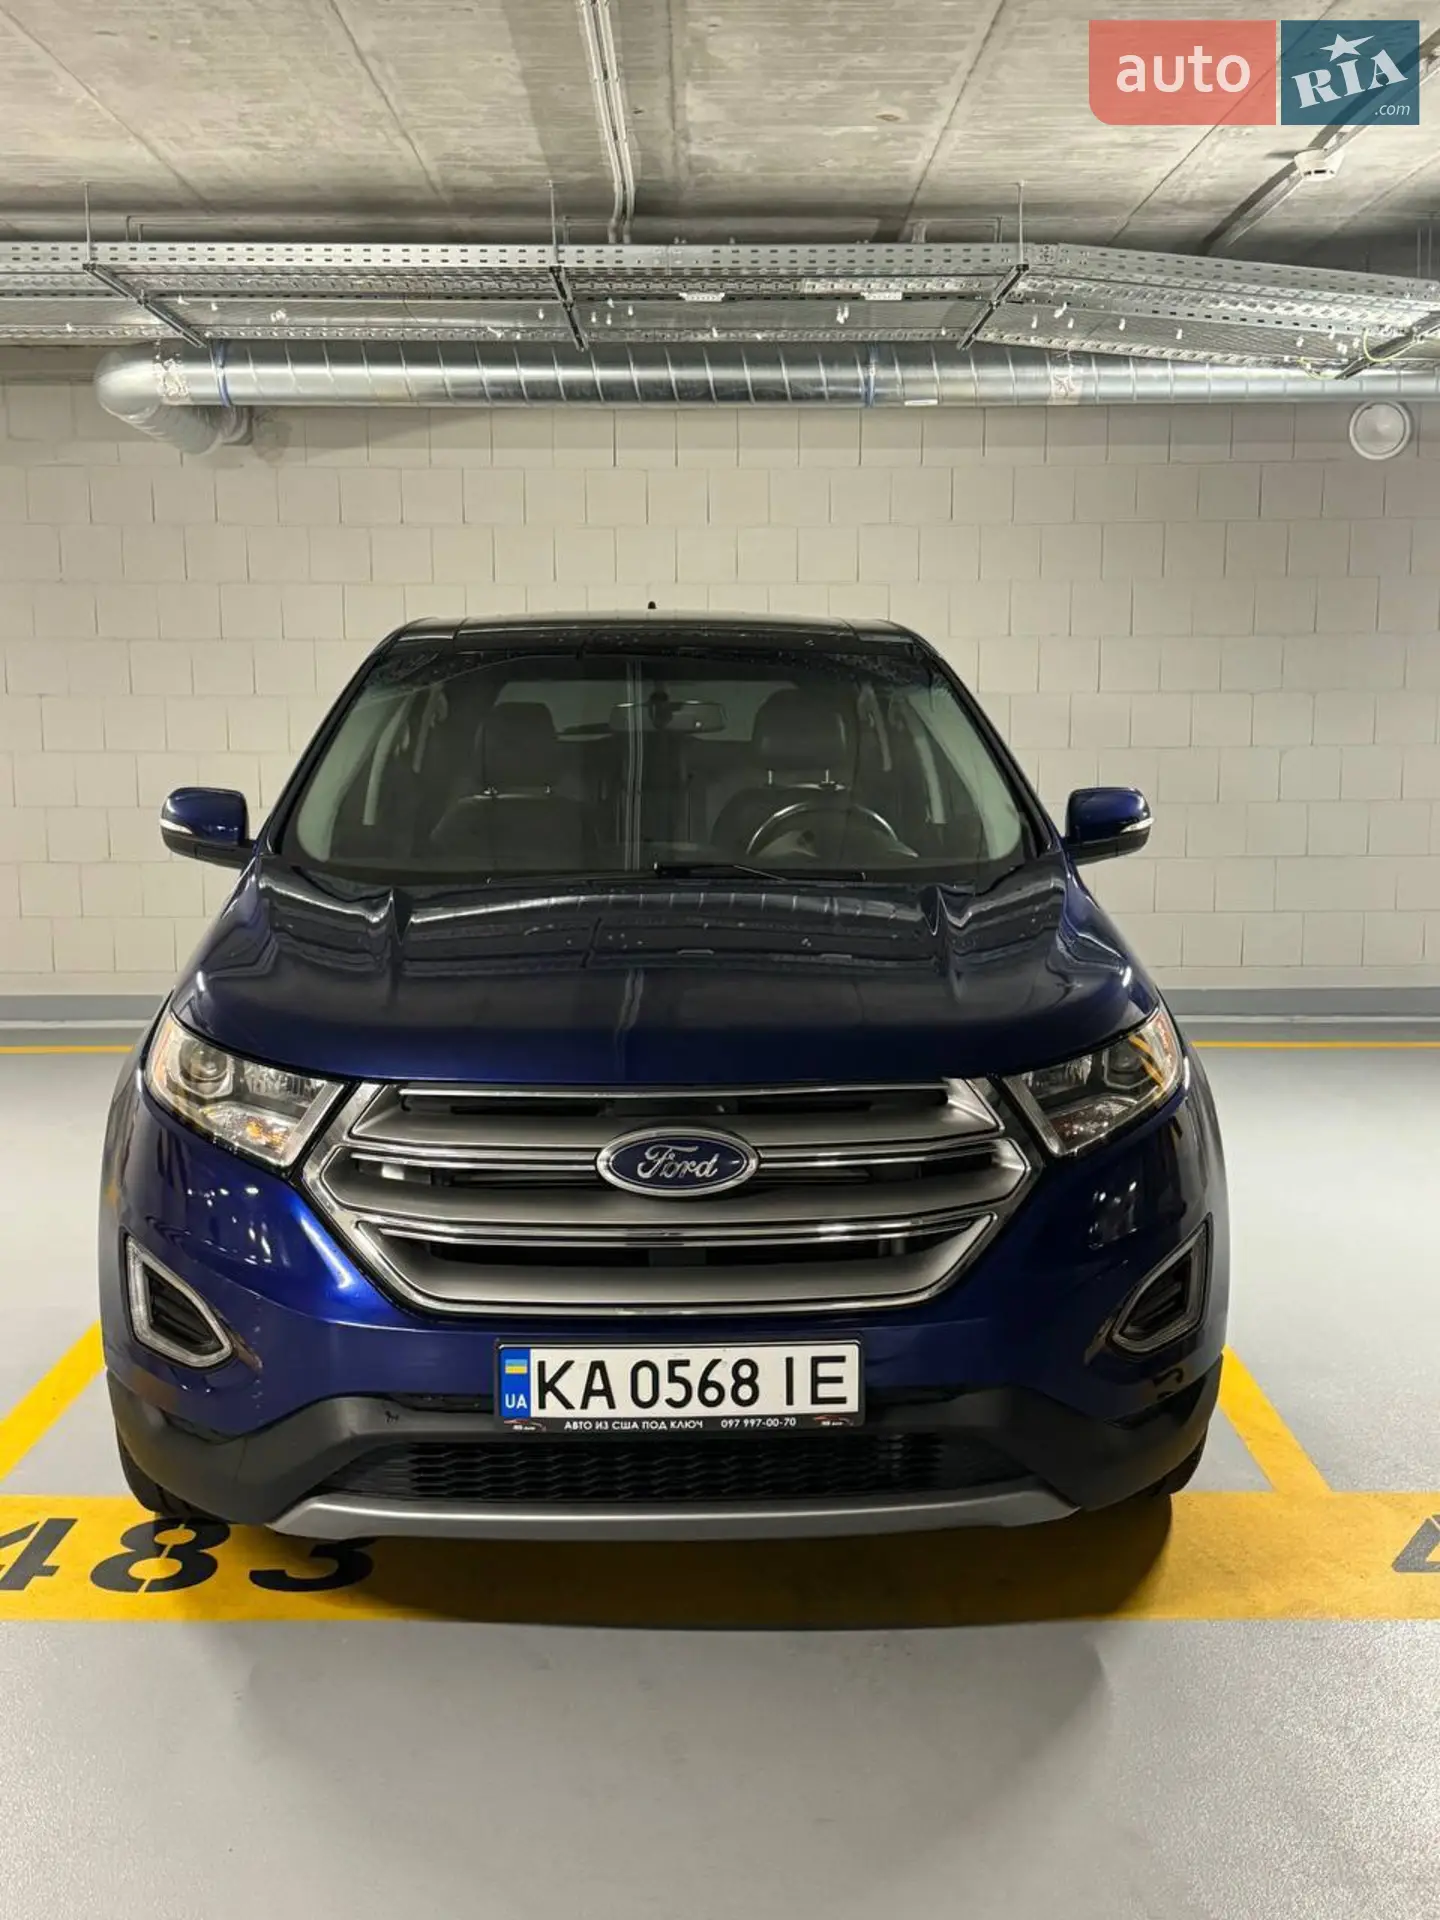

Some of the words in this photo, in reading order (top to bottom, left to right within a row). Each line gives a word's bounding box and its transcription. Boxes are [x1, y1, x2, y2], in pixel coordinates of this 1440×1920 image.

[637, 1144, 720, 1179] Ford
[537, 1360, 616, 1409] KA
[630, 1358, 760, 1408] 0568
[785, 1356, 847, 1405] IE
[505, 1394, 528, 1409] UA
[564, 1421, 592, 1430] АВТО
[595, 1420, 609, 1430] ИЗ
[611, 1420, 640, 1430] США
[642, 1419, 668, 1430] ПОД
[670, 1419, 704, 1430] КЛЮЧ
[720, 1419, 740, 1429] 097
